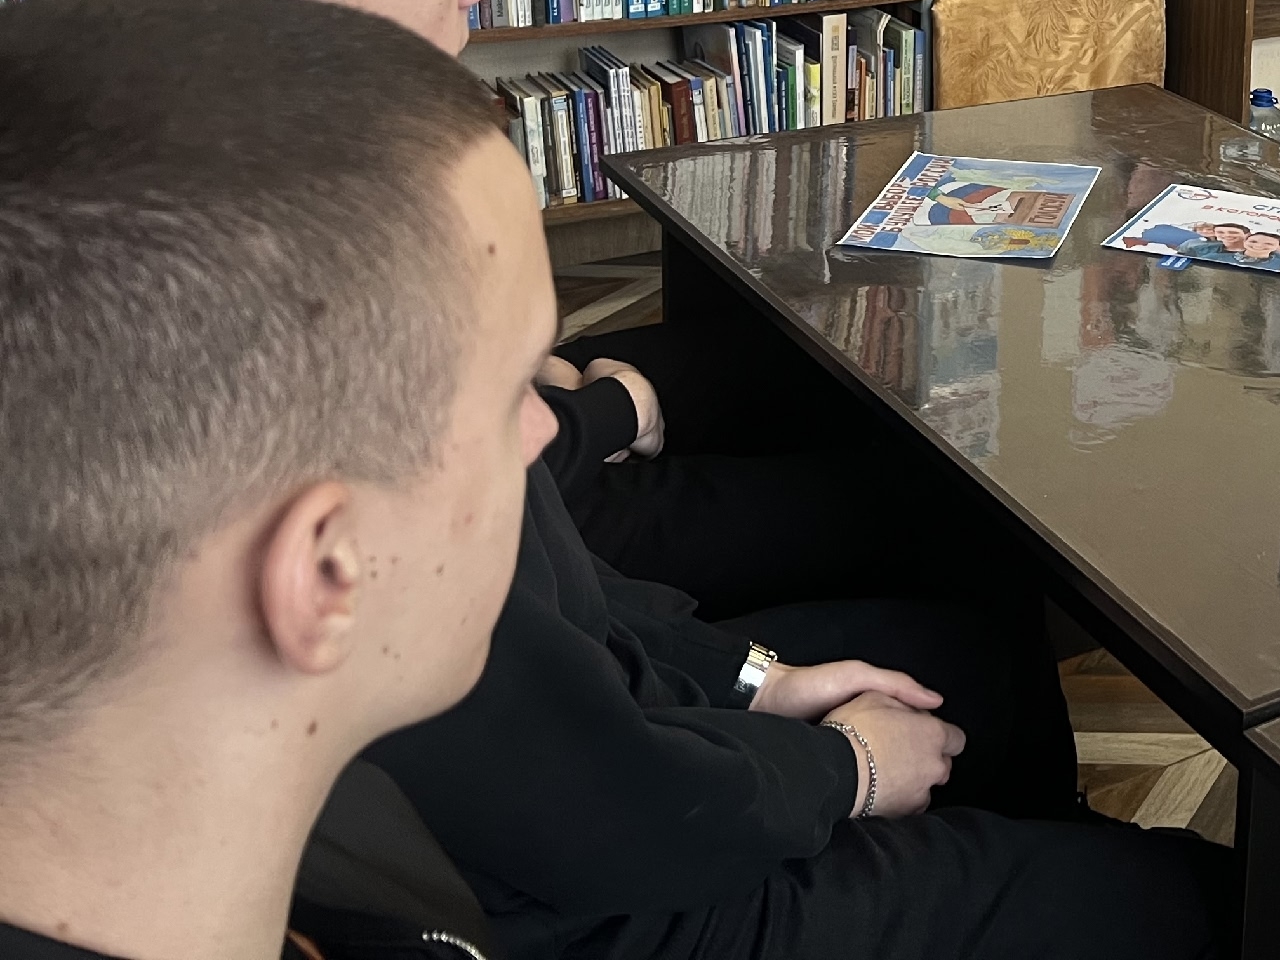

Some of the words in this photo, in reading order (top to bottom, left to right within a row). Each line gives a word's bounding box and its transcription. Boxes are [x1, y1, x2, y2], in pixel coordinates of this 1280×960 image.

[882, 196, 926, 232] БУДУЩЕЕ
[916, 157, 956, 188] РОССИИ
[1028, 192, 1070, 224] ГОЛОСУЙ
